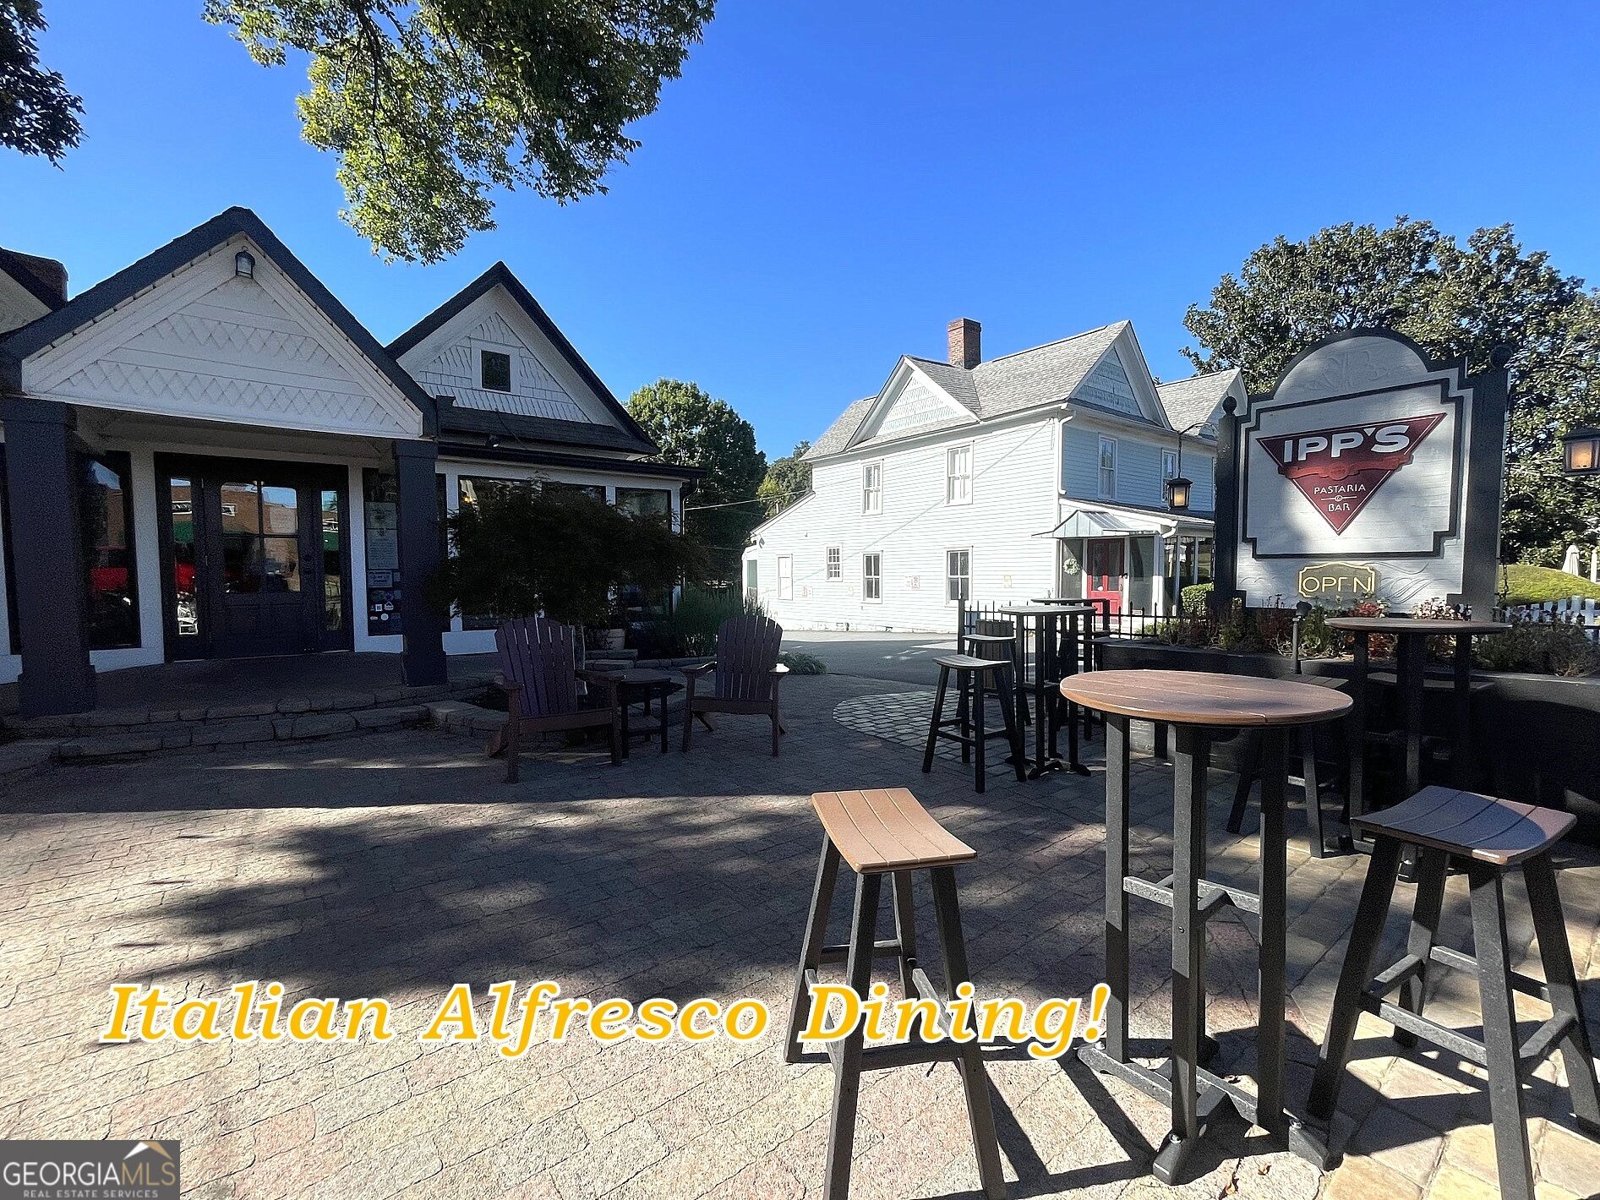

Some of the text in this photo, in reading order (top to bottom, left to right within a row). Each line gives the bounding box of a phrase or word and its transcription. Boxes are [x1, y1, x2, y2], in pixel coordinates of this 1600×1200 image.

[1283, 425, 1410, 463] IPP'S
[1313, 483, 1366, 494] PASTARIA
[1328, 502, 1350, 512] BAR
